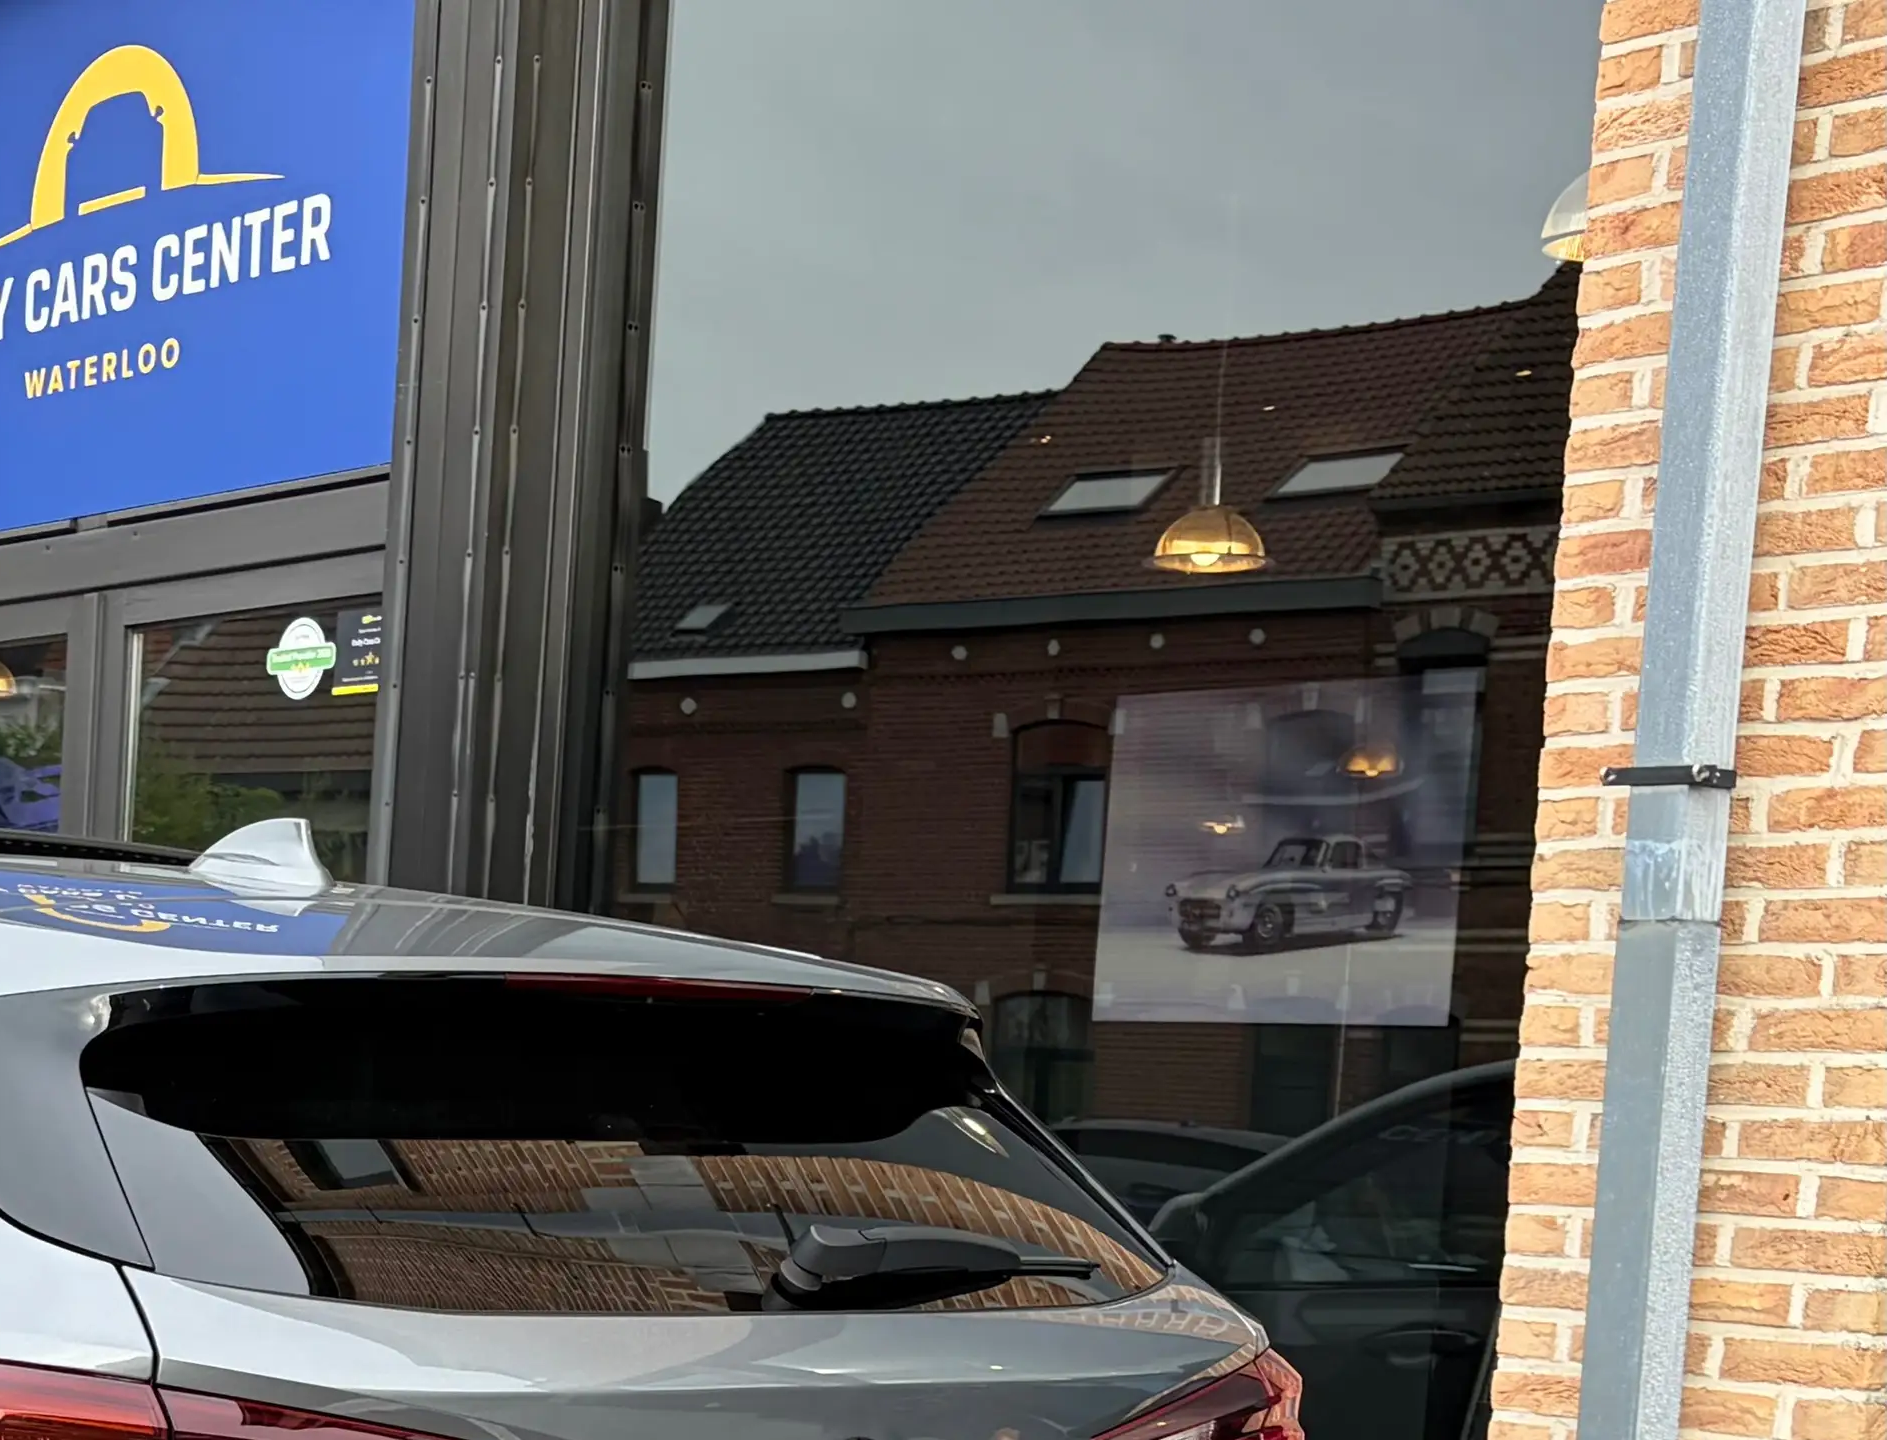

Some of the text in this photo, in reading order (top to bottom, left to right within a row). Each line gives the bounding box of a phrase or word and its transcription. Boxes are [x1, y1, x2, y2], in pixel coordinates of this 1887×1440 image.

[24, 244, 137, 333] CARS
[151, 193, 332, 302] CENTER
[24, 337, 180, 399] WATERLOO
